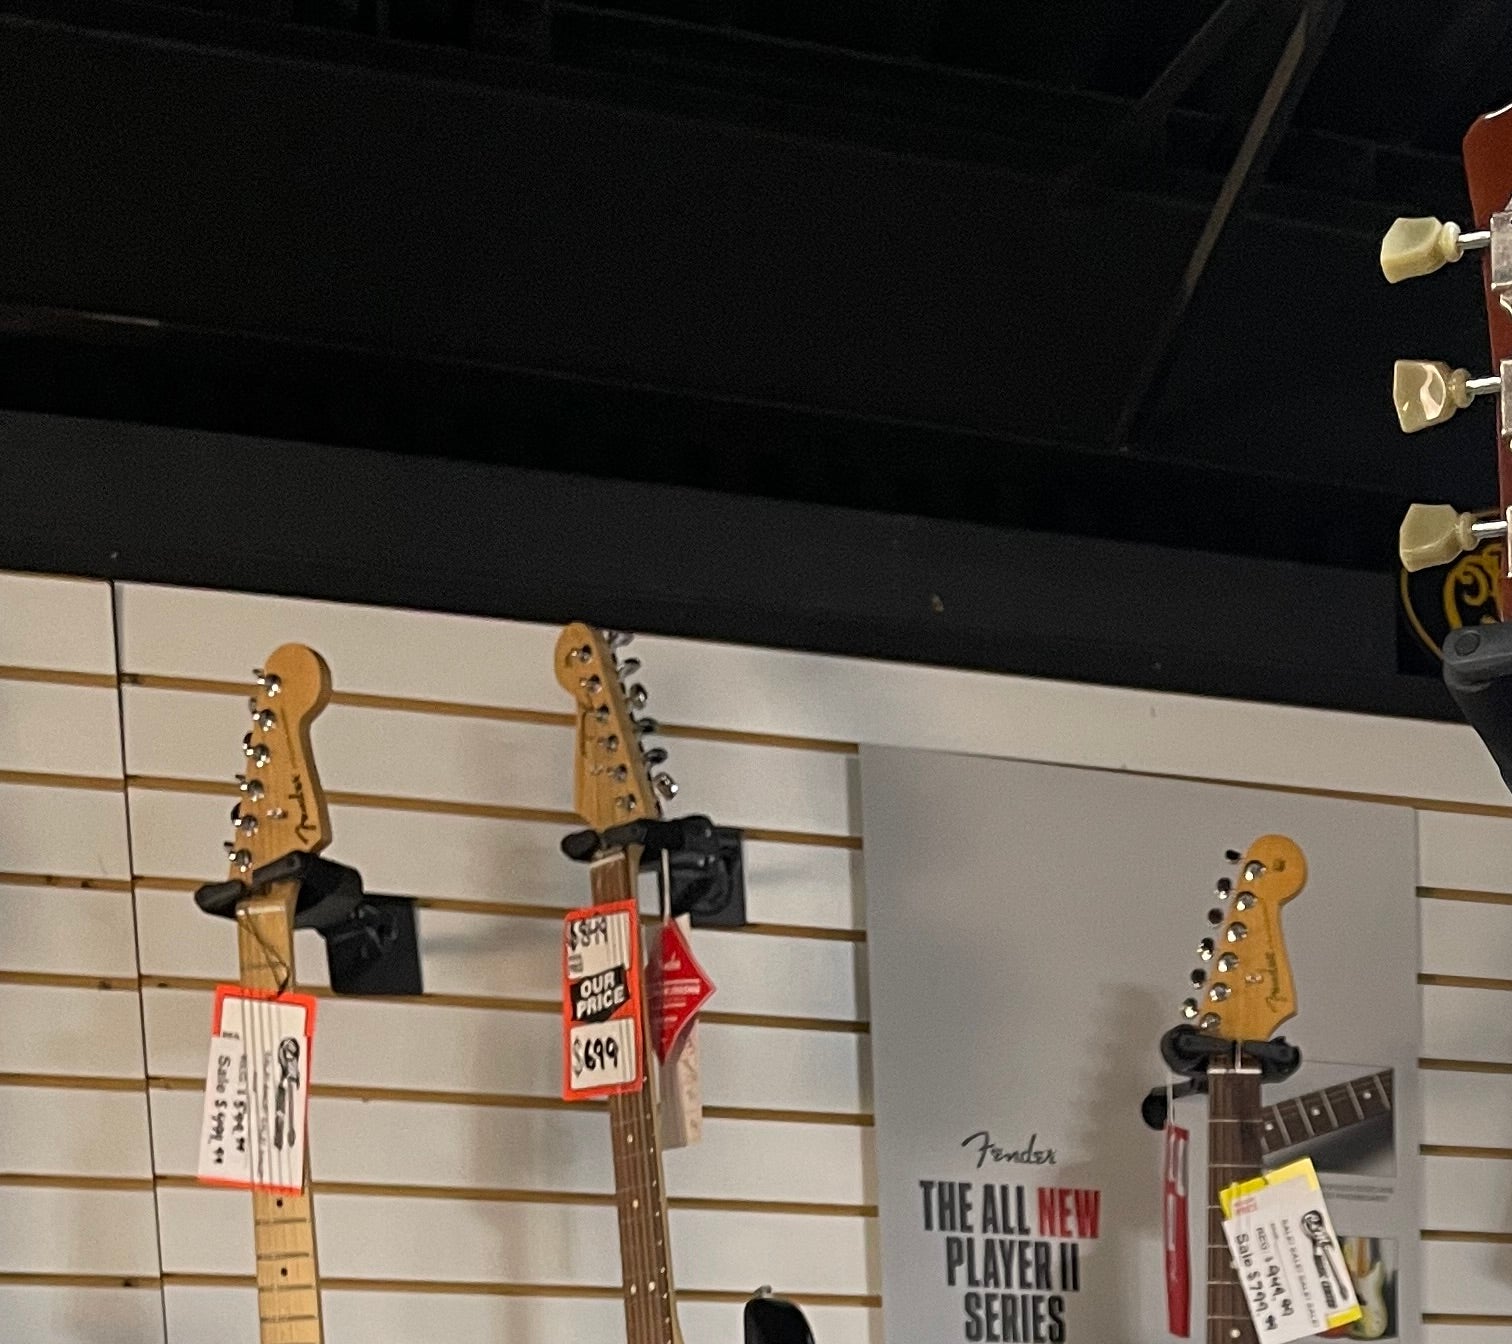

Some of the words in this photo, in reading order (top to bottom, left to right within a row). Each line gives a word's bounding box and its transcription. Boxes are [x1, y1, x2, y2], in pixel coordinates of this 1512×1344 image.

[576, 986, 624, 1021] PRICE
[580, 974, 616, 998] OUR
[215, 1055, 231, 1094] Sale
[573, 1036, 619, 1077] $699
[961, 1131, 1057, 1168] Fender
[919, 1179, 973, 1233] THE
[982, 1183, 1031, 1236] ALL
[1037, 1186, 1100, 1239] NEW
[946, 1236, 1052, 1291] PLAYER
[1060, 1242, 1080, 1291] II
[1233, 1231, 1259, 1269] Sale
[964, 1292, 1066, 1344] SERIES
